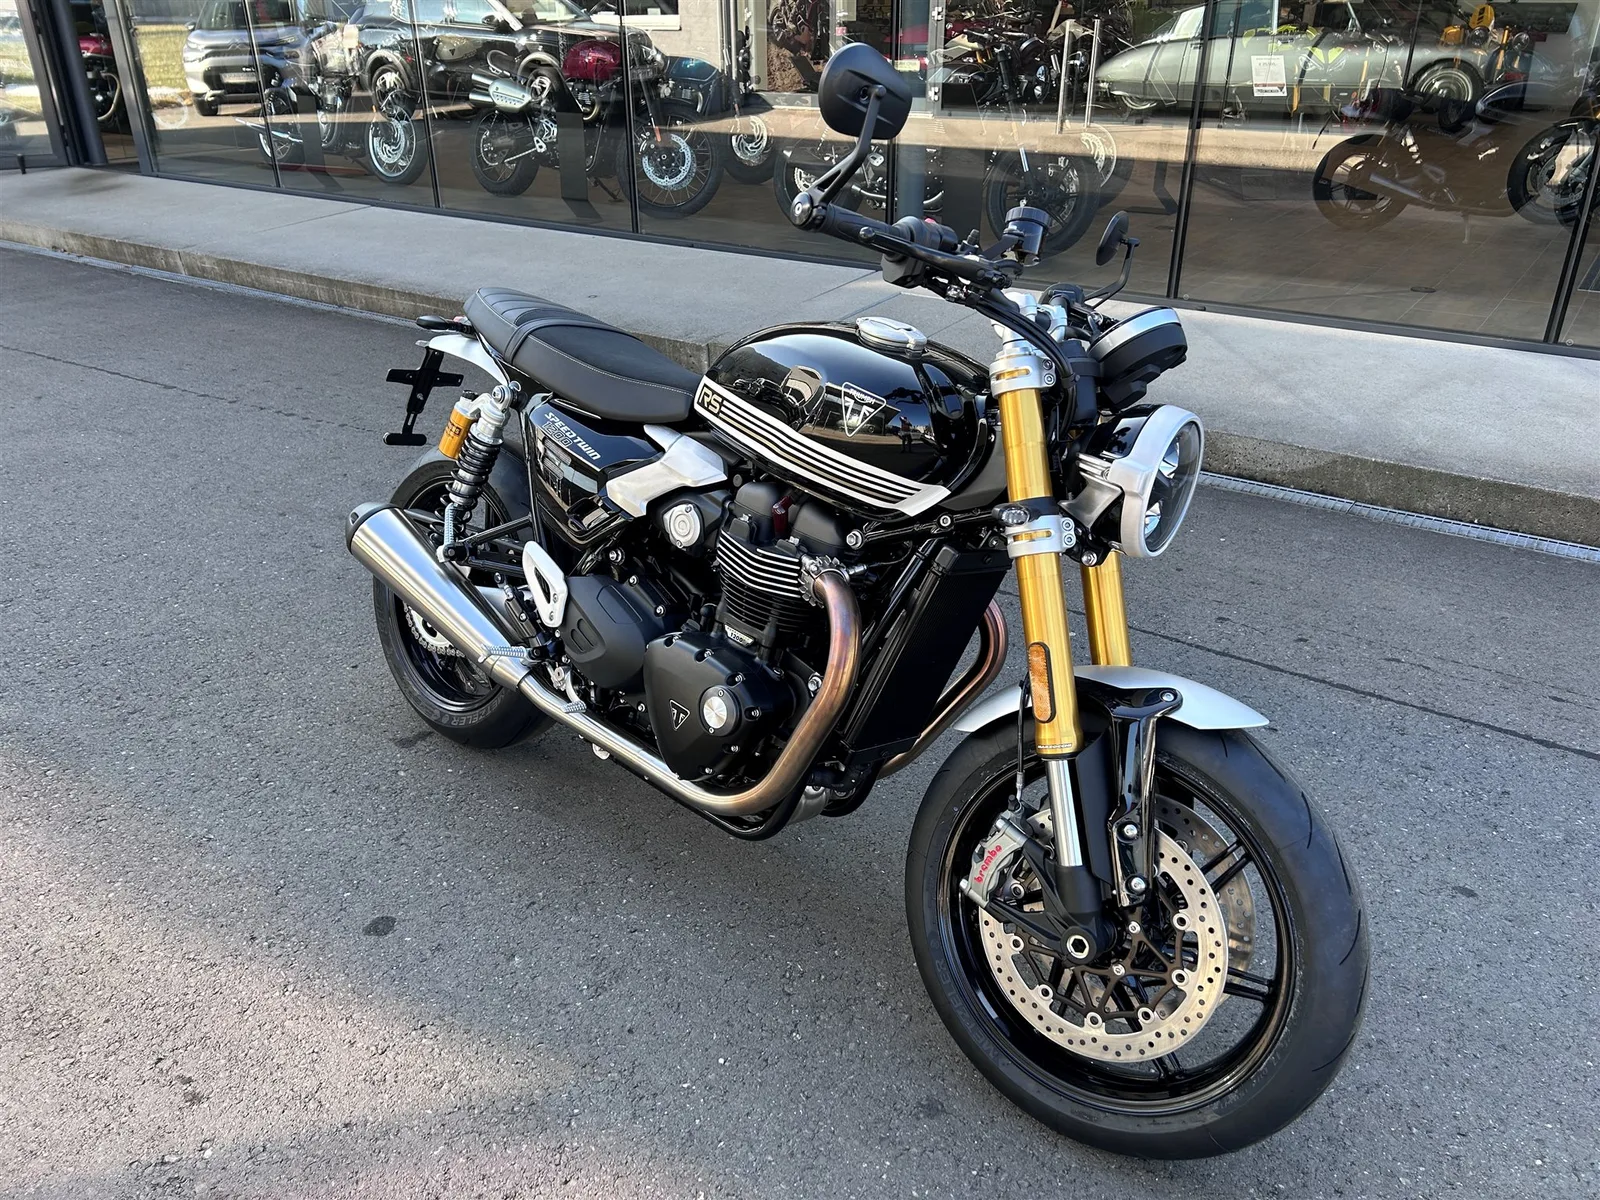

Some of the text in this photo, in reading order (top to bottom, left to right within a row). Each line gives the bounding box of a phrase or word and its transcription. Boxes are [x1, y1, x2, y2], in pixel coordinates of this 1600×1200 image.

[699, 386, 722, 414] RS
[849, 388, 876, 405] TRIUMPH
[541, 421, 573, 448] 1200
[544, 412, 601, 460] SPEED TWIN
[974, 845, 1002, 883] brembo
